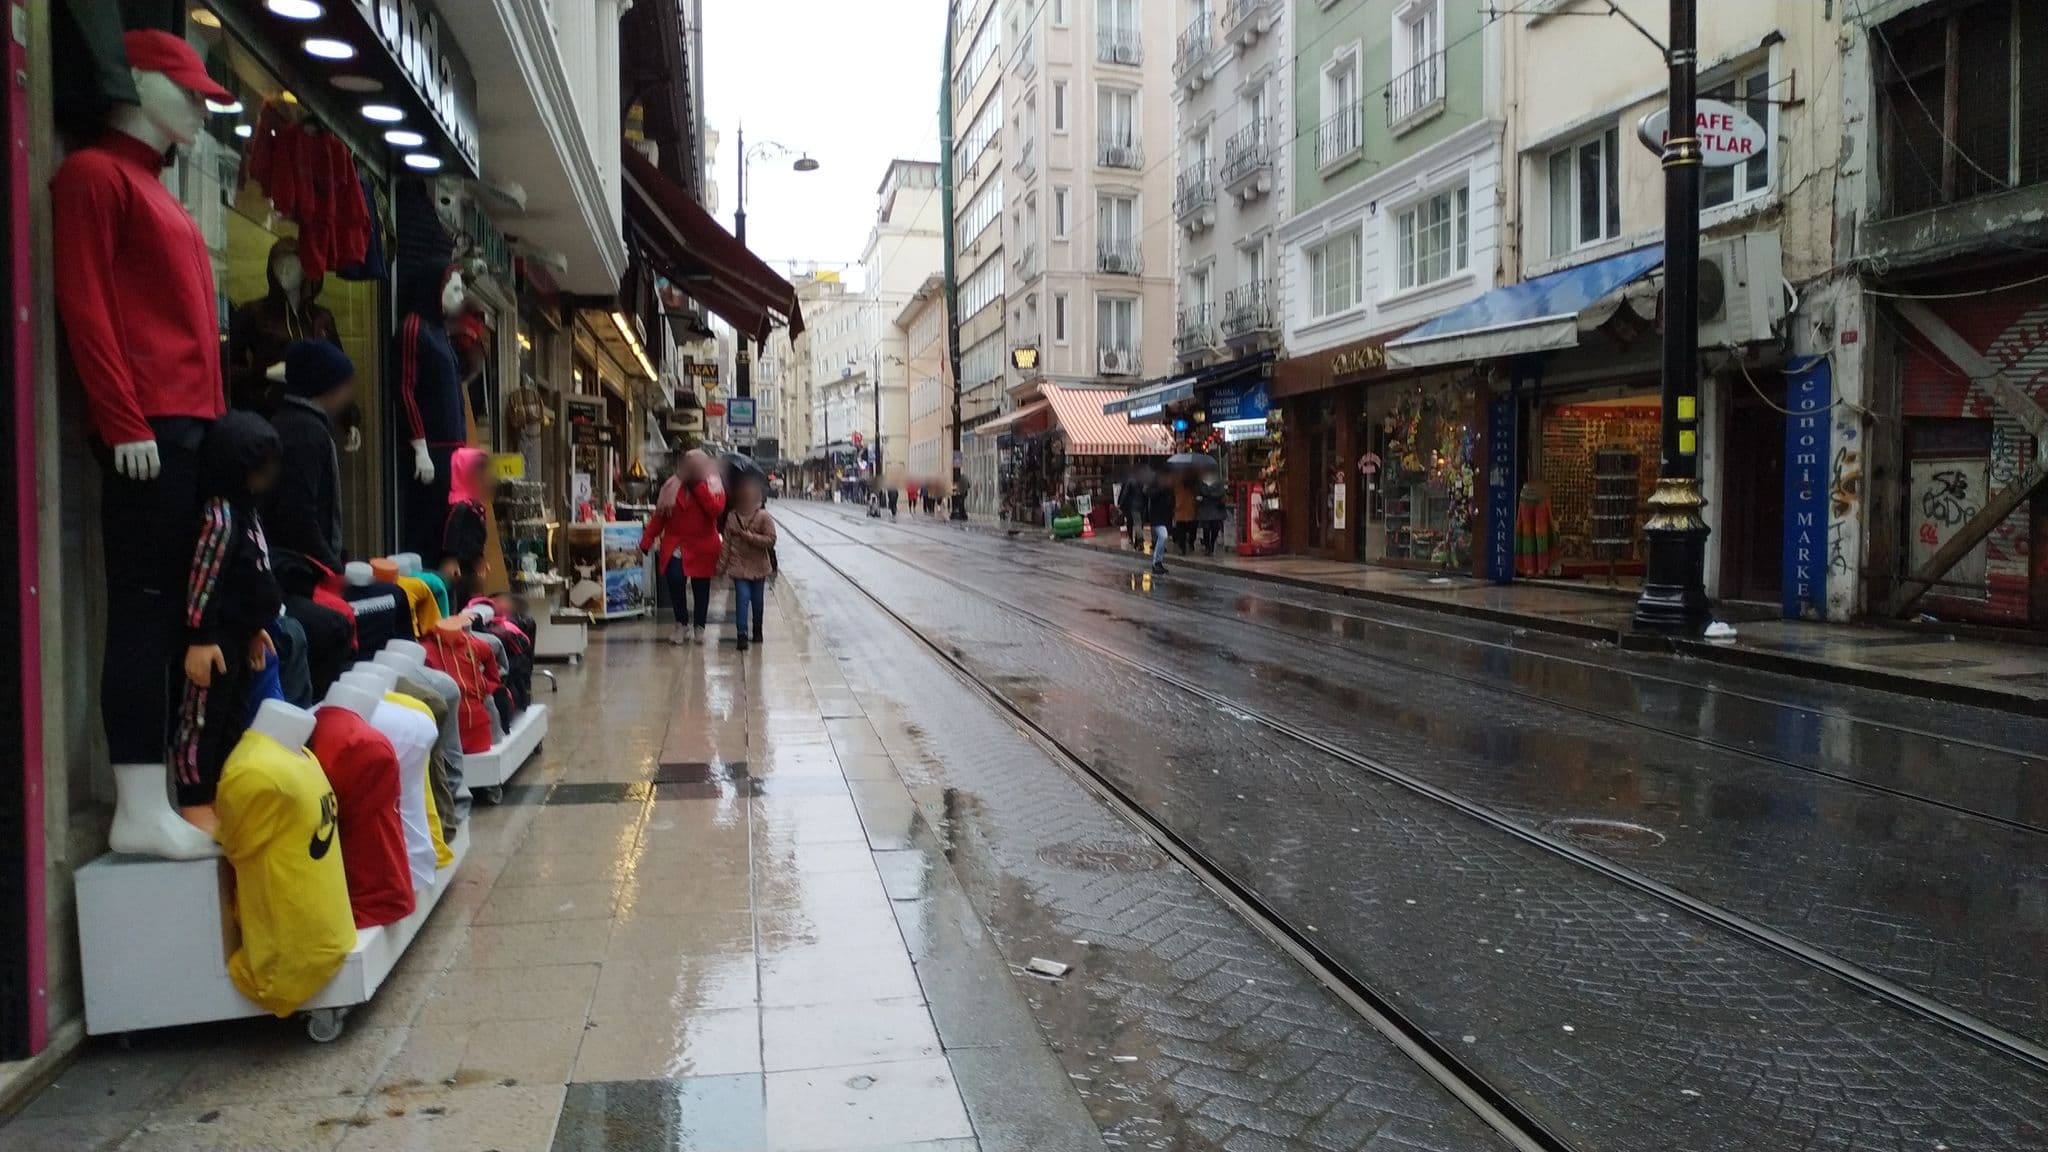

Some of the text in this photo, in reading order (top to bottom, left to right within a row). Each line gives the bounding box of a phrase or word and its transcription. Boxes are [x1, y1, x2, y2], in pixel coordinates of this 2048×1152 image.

[352, 0, 457, 137] anda
[1695, 112, 1734, 132] AFE
[1661, 129, 1752, 155] TLAR
